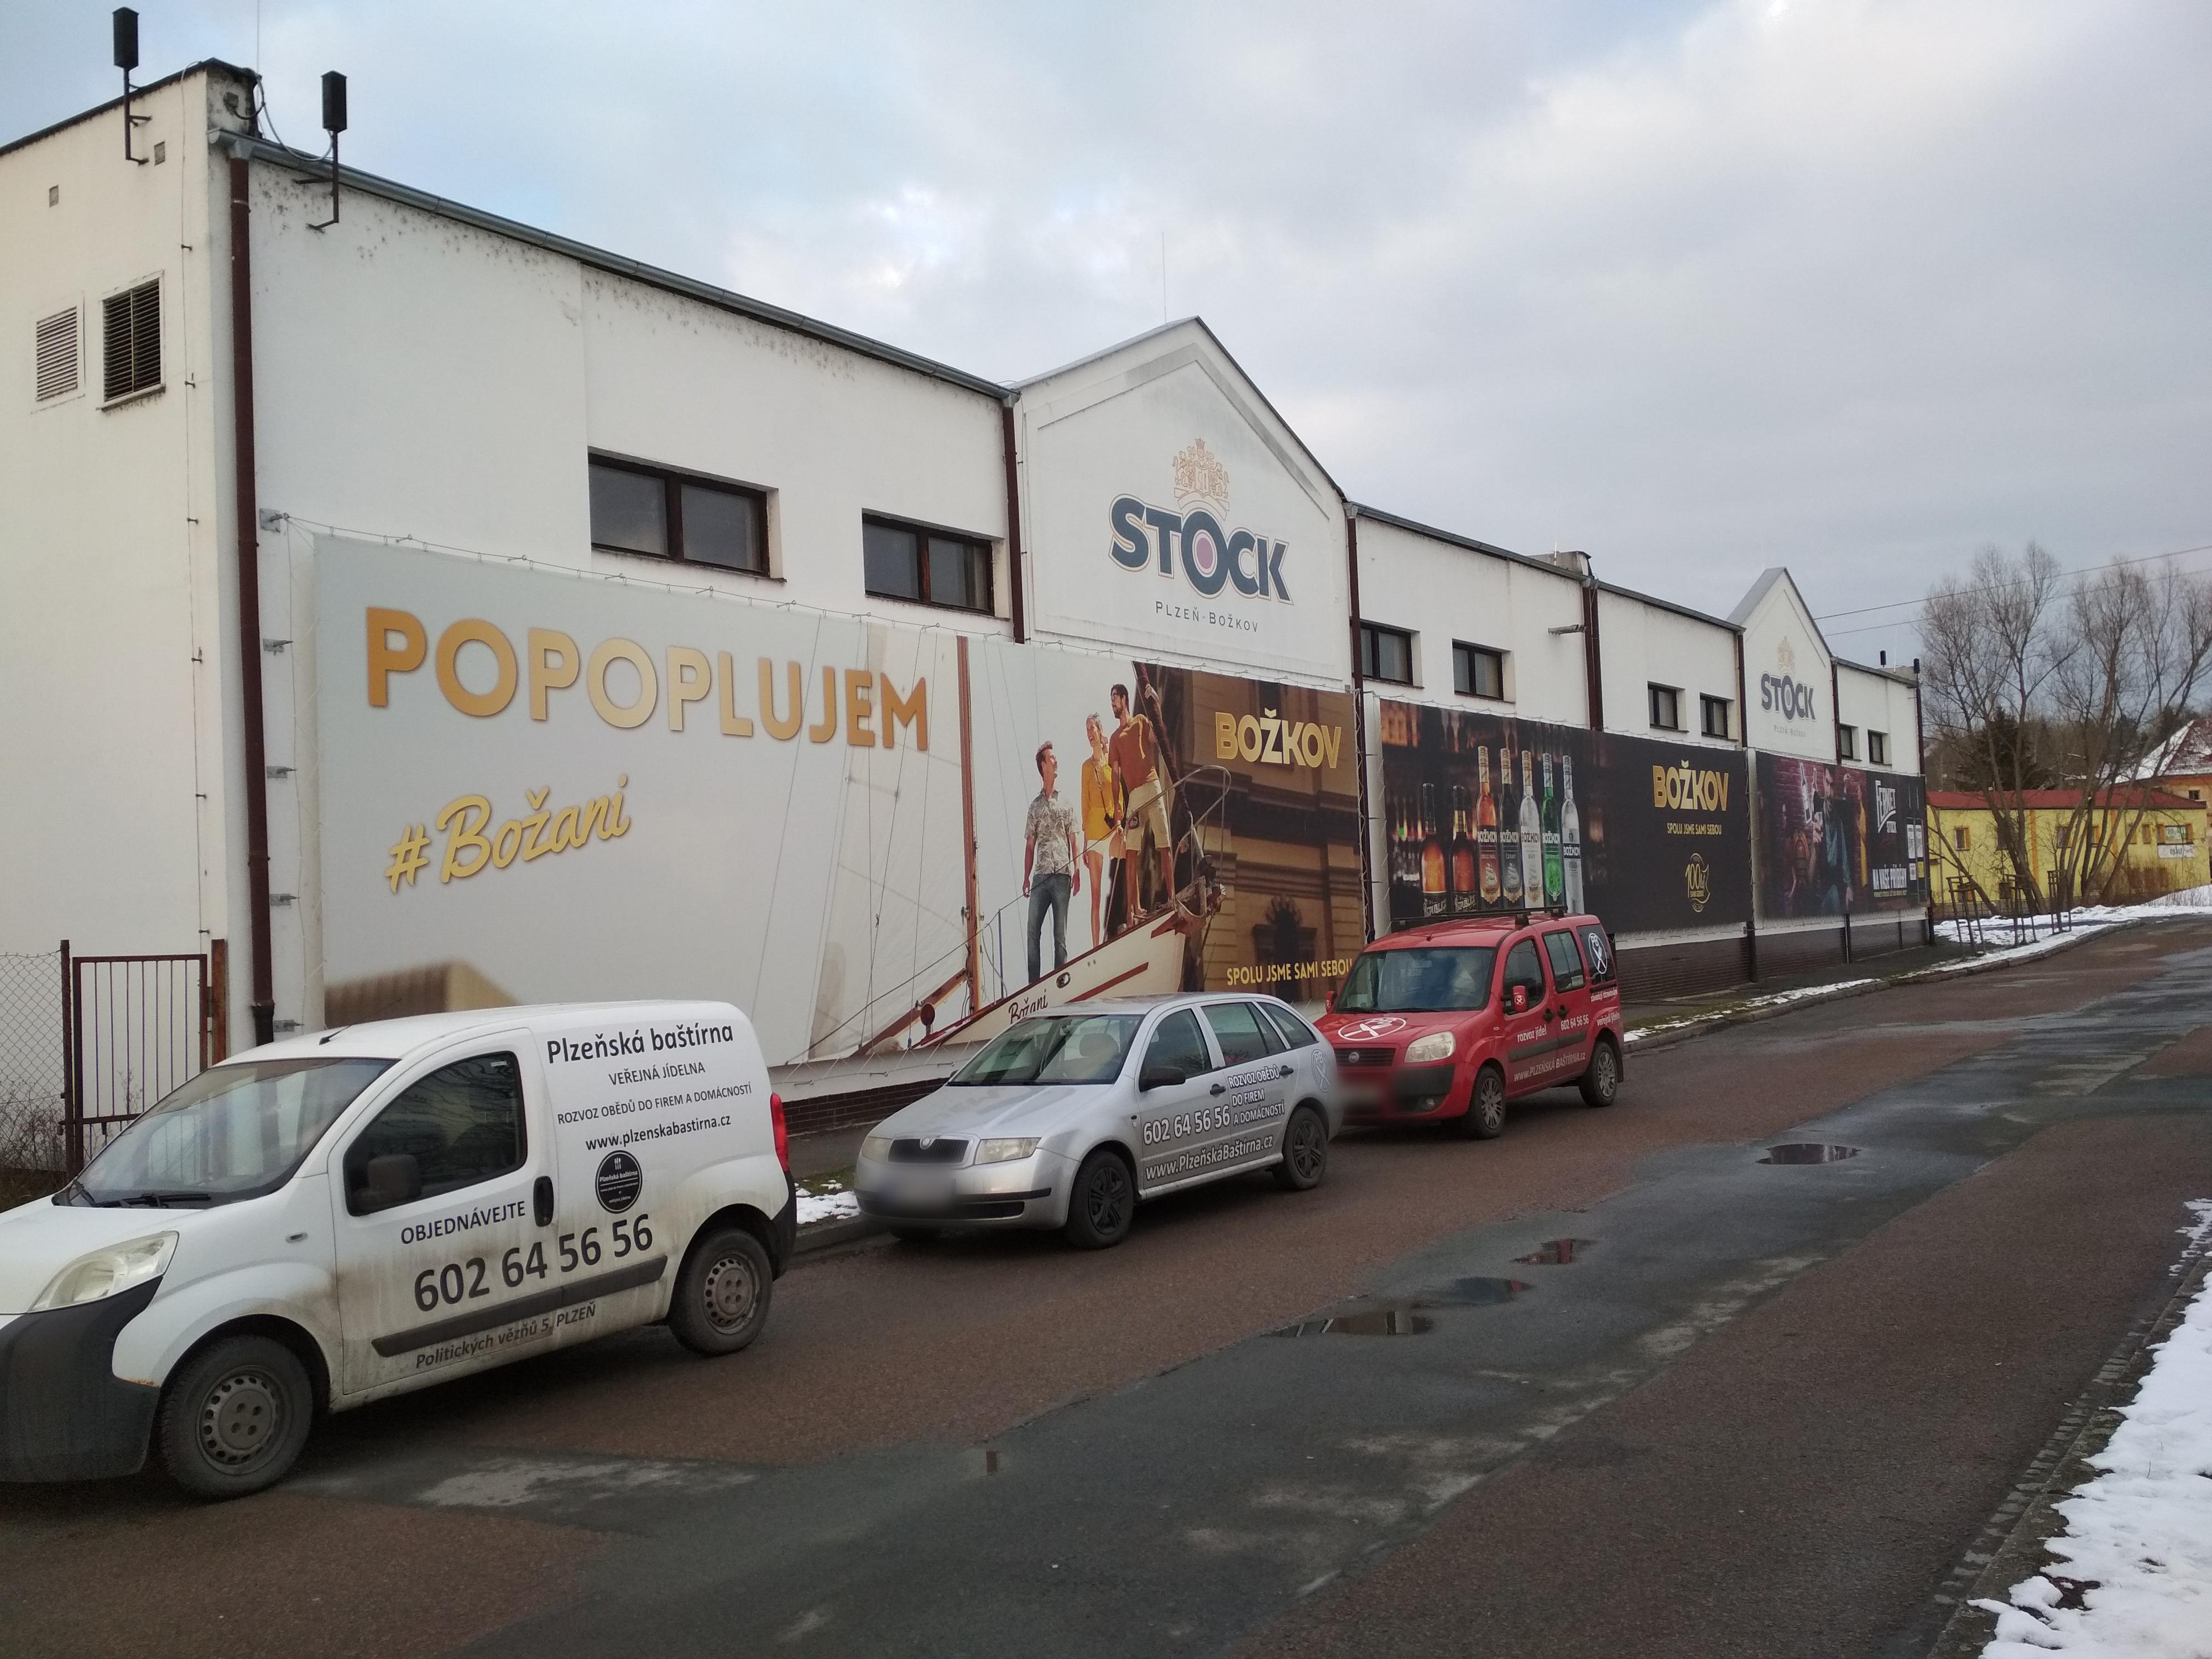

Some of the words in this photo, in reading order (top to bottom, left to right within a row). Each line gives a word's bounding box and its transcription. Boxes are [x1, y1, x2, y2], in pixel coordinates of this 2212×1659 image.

[1108, 493, 1294, 606] STOCK
[366, 606, 927, 751] POPOPLUJEM
[1760, 670, 1817, 723] STOCK
[1215, 707, 1342, 769] BOŽKOV
[1652, 759, 1729, 811] BOŽKOV
[384, 774, 631, 894] #Božani
[1667, 822, 1682, 834] SPOLU
[1683, 823, 1694, 834] JSME
[1695, 823, 1707, 834] SAMI
[1707, 824, 1721, 835] SEBOU
[1685, 863, 1700, 898] 100
[1227, 966, 1263, 985] SPOLU
[1266, 963, 1292, 982] JSME
[1294, 961, 1318, 979] SAMI
[547, 1029, 645, 1064] Plzeňská
[650, 1022, 734, 1051] baštírna
[1517, 1033, 1534, 1043] rozvoz
[1535, 1024, 1547, 1040] jídel
[1561, 1020, 1570, 1031] 602
[1570, 1018, 1576, 1029] 64
[1576, 1016, 1583, 1027] 56
[1583, 1014, 1589, 1025] 56
[608, 1065, 660, 1086] VEŘEJNÁ
[662, 1061, 706, 1078] JÍDELNA
[1228, 1072, 1256, 1089] ROZVOZ
[1257, 1065, 1280, 1083] OBĚDŮ
[557, 1108, 599, 1125] ROZVOZ
[601, 1099, 635, 1117] OBĚDŮ
[638, 1099, 653, 1111] DO
[655, 1094, 684, 1108] FIREM
[686, 1093, 692, 1104] A
[694, 1081, 752, 1103] DOMÁCNOSTÍ
[1232, 1093, 1243, 1107] DO
[1244, 1088, 1265, 1104] FIREM
[1233, 1112, 1239, 1125] A
[1240, 1100, 1285, 1124] DOMÁCNOSTÍ
[586, 1115, 732, 1151] www.plzenskabastirna.cz
[1143, 1118, 1171, 1145] 602
[1173, 1113, 1191, 1138] 64
[1194, 1109, 1212, 1134] 56
[1214, 1105, 1231, 1129] 56
[1146, 1135, 1274, 1181] www.PlzeňskáBaštírna.cz
[400, 1201, 526, 1244] OBJEDNÁVEJTE
[414, 1257, 490, 1312] 602
[502, 1241, 548, 1287] 64
[559, 1227, 601, 1272] 56
[612, 1213, 653, 1258] 56
[415, 1333, 494, 1369] Politických
[498, 1318, 538, 1345] vězňů
[556, 1301, 596, 1328] PLZEŇ
